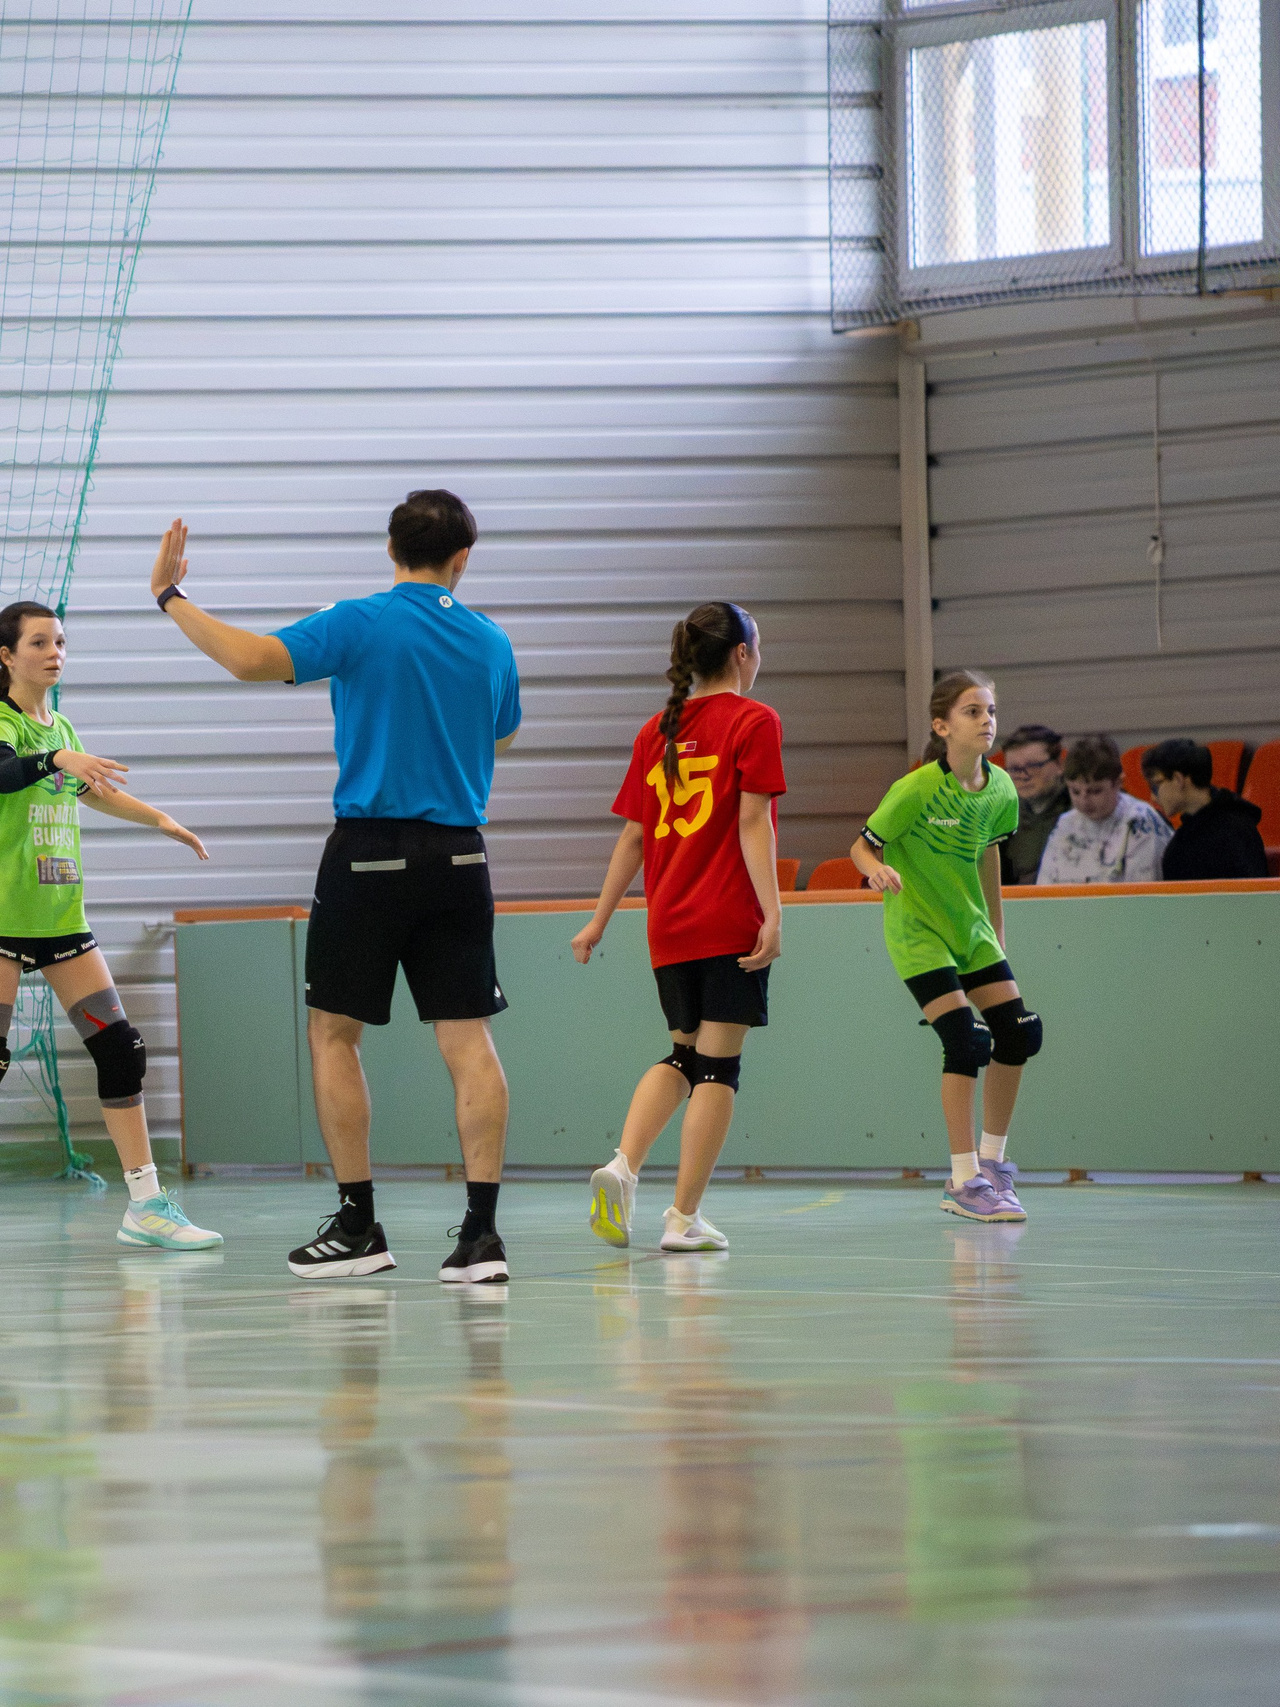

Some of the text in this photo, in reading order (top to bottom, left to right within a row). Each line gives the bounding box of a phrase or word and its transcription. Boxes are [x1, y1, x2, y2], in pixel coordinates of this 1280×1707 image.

[646, 755, 719, 840] 15
[20, 953, 36, 965] Kemp
[53, 948, 78, 961] Kempa
